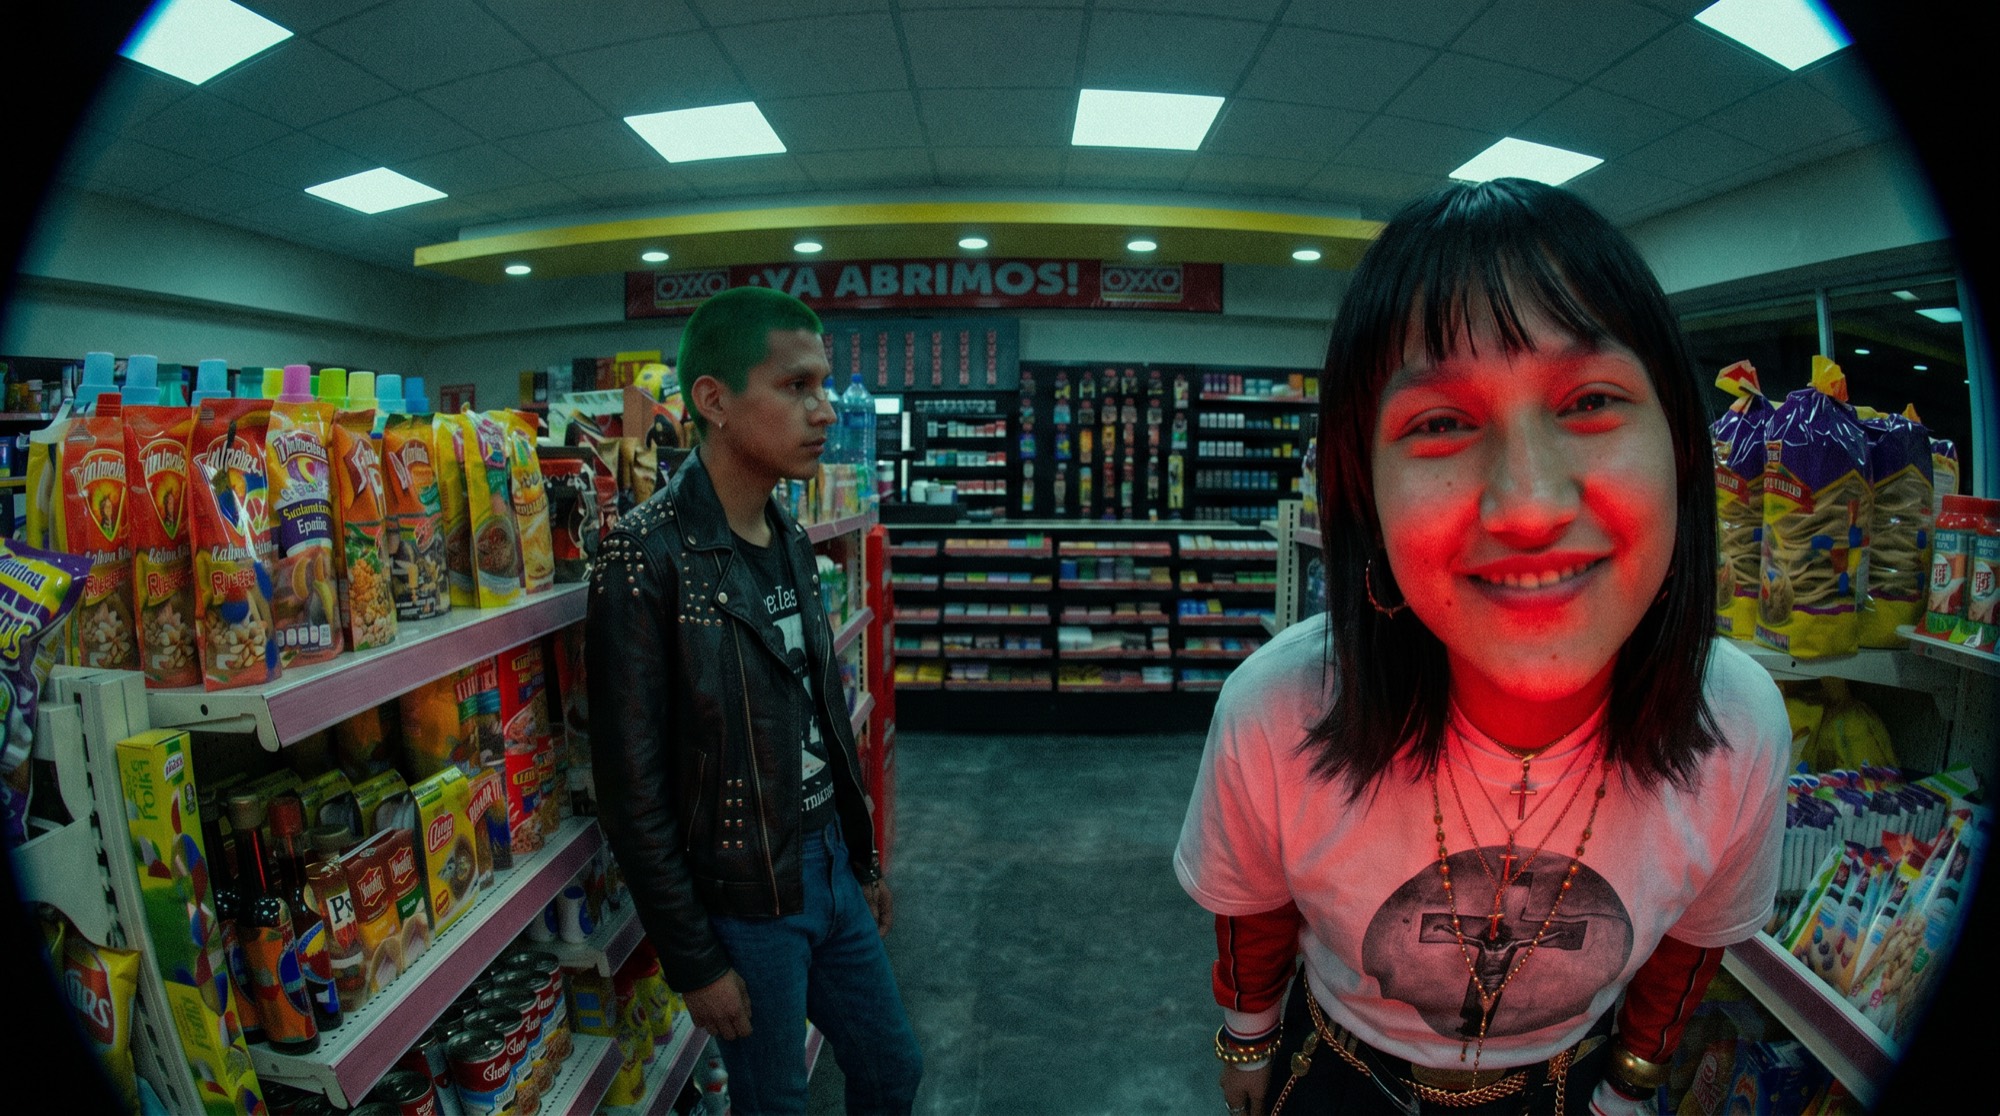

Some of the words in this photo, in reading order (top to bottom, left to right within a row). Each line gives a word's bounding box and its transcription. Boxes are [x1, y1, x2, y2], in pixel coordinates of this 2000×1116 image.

[656, 273, 728, 300] OXXO
[748, 266, 823, 298] YA
[834, 262, 1079, 299] ABRIMOS!
[1103, 267, 1181, 294] OXXO
